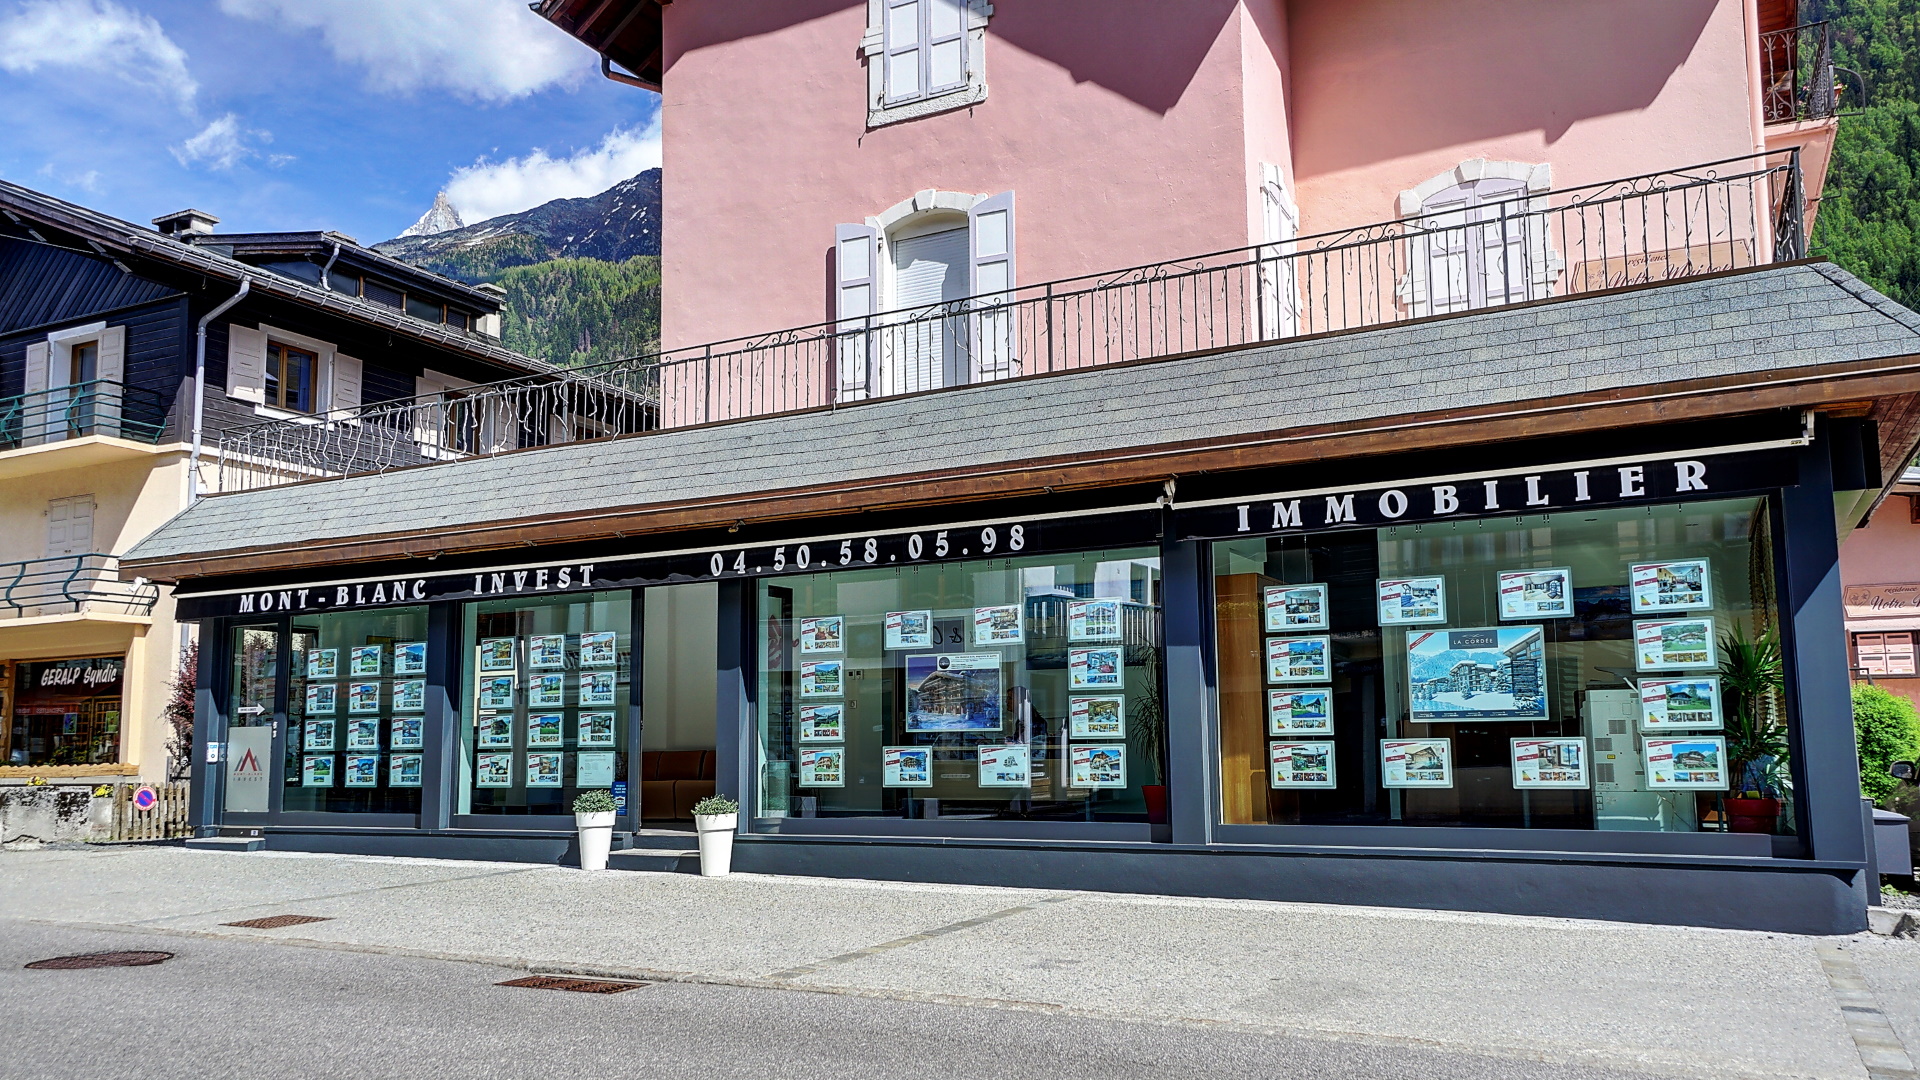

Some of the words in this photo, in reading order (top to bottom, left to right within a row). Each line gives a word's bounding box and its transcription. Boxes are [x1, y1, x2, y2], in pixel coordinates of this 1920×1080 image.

[1237, 461, 1709, 532] IMMOBILIER
[711, 525, 1025, 577] 04.50.58.05.98
[474, 565, 594, 596] INVEST
[1871, 596, 1905, 610] Notre
[41, 667, 81, 686] GERALP
[83, 663, 117, 688] Syndic
